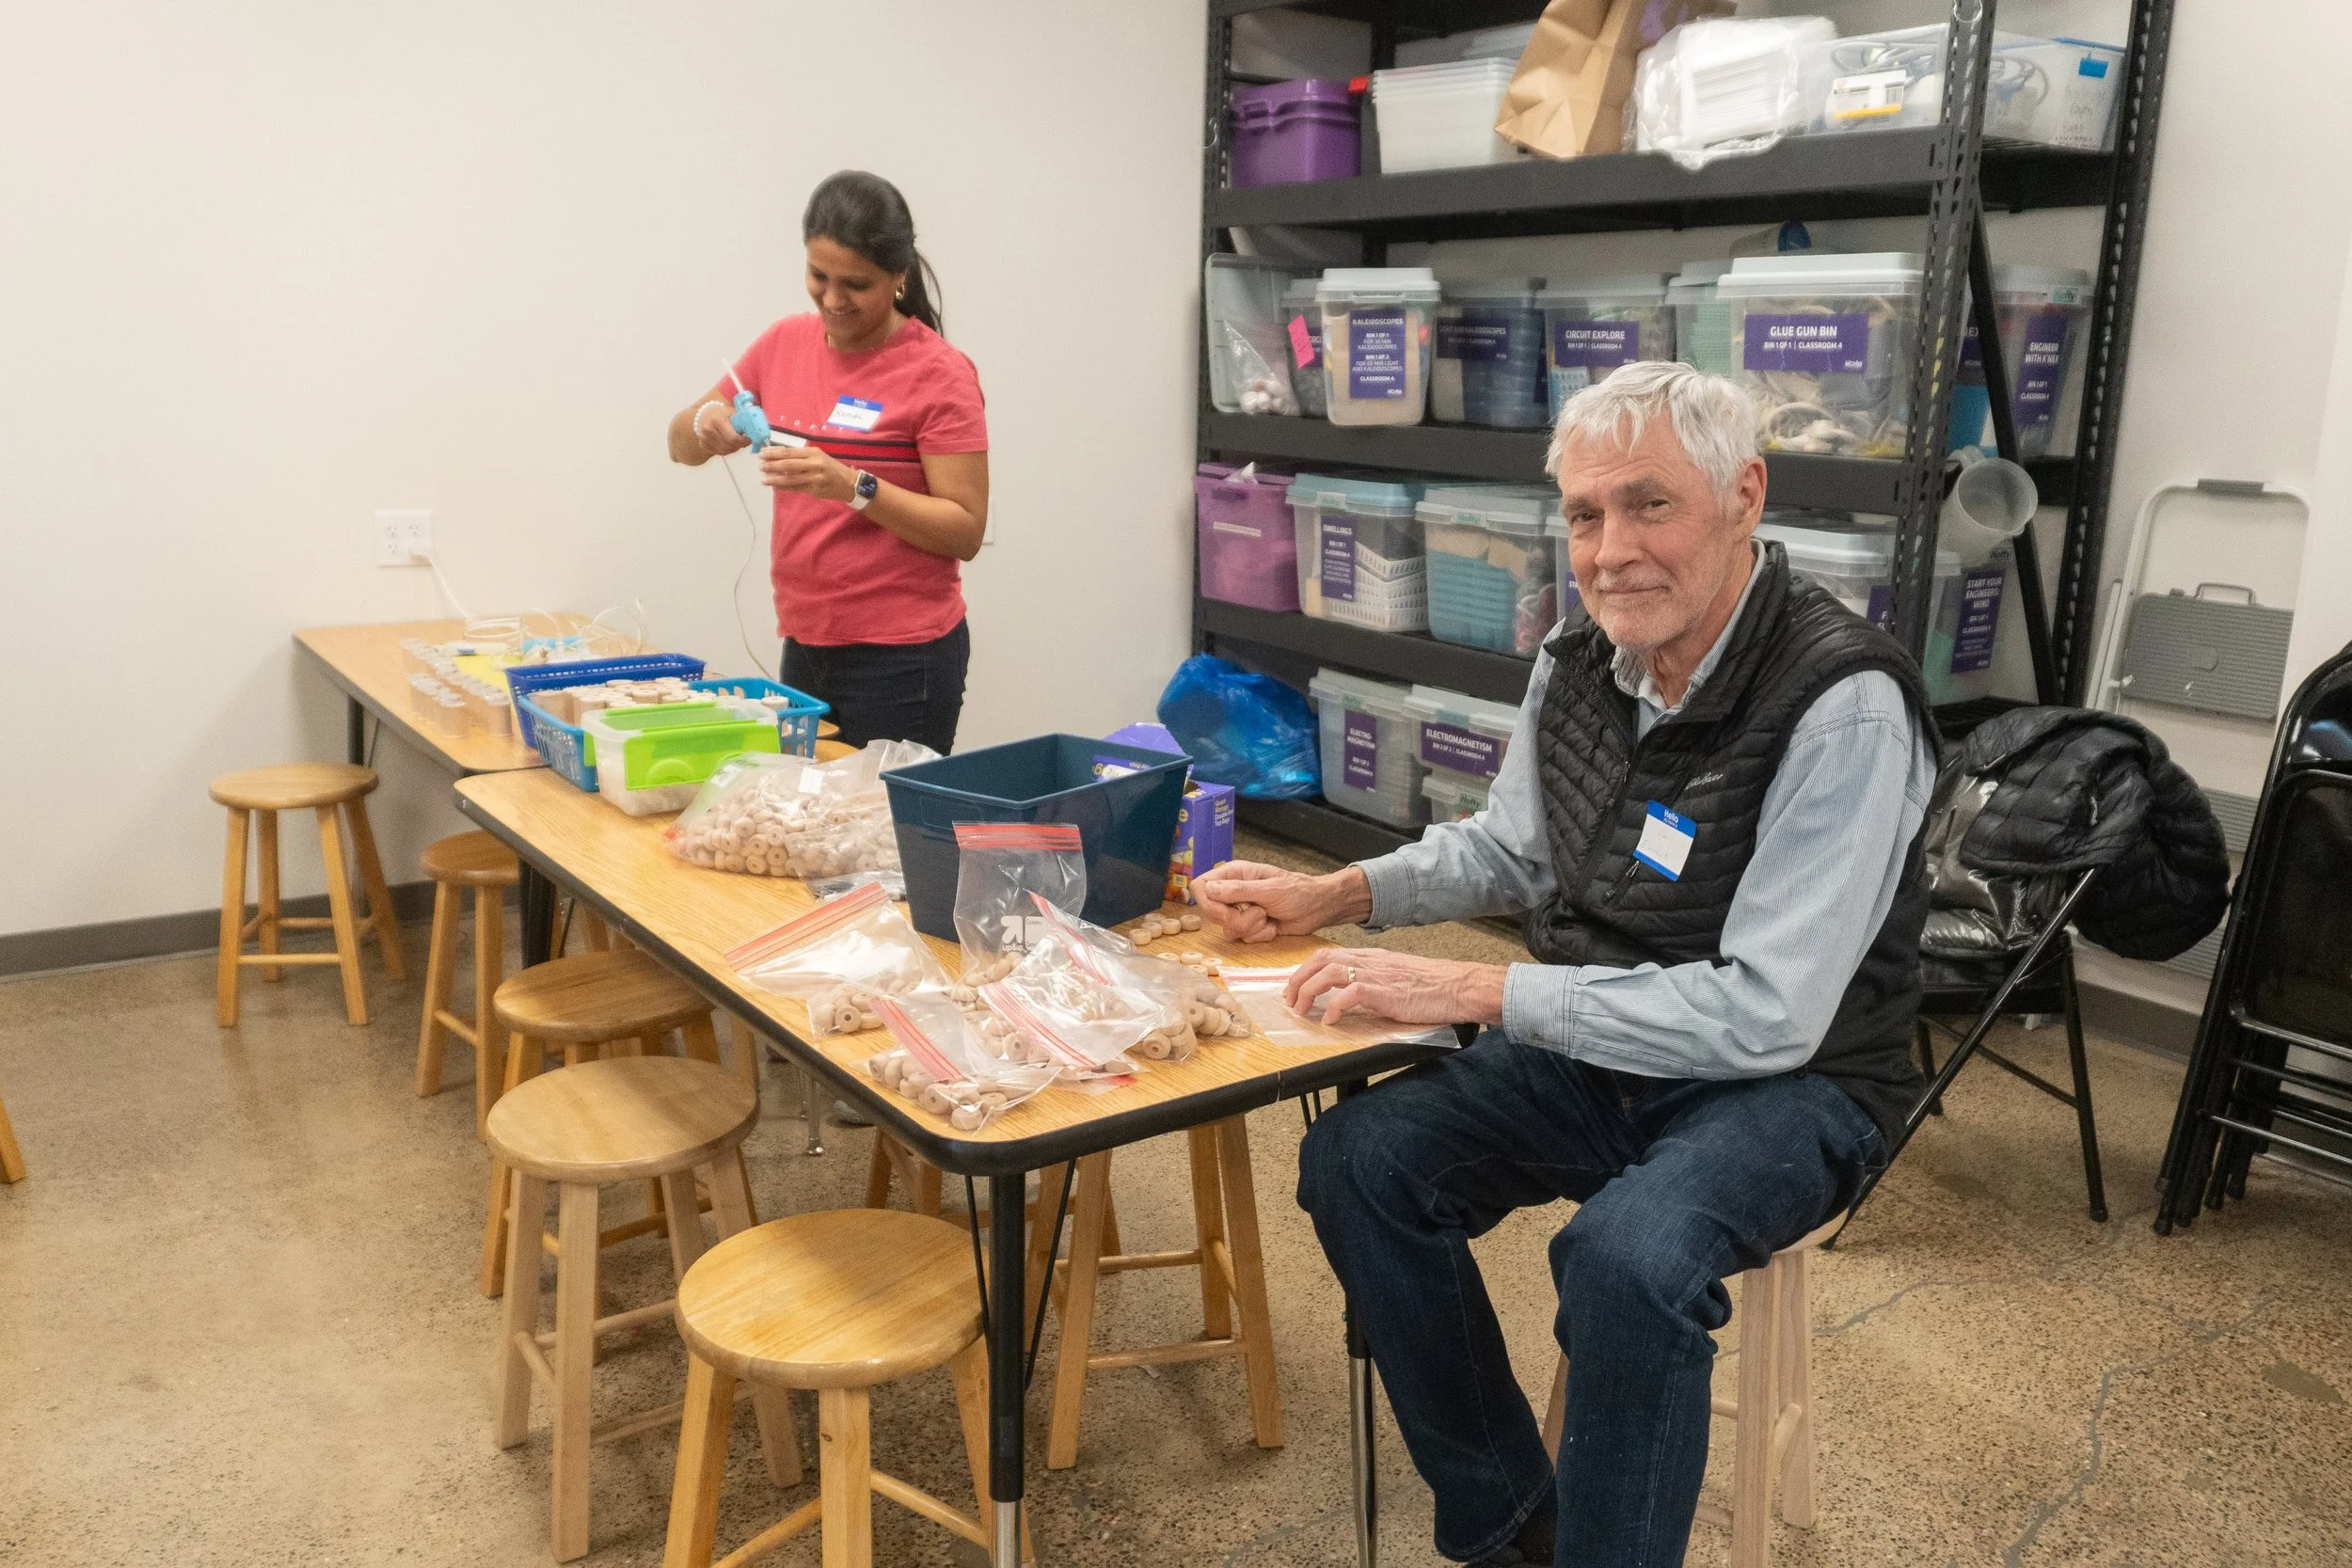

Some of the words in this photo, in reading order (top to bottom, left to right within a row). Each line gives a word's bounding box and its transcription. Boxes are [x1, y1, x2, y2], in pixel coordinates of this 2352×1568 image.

[1565, 330, 1591, 339] CIRCUIT
[1592, 330, 1626, 340] EXPLORE
[1770, 325, 1794, 337] GLUE
[1796, 325, 1818, 337] GUN
[1820, 325, 1837, 337] BIN
[1763, 341, 1775, 350] BIN
[1798, 341, 1836, 350] CLASSROOM
[2030, 342, 2058, 352] ENGINEER
[2025, 354, 2042, 364] WITH
[1323, 524, 1352, 535] DWELLINGS
[1967, 578, 1986, 589] START
[1987, 577, 2003, 586] YOUR
[1973, 599, 1991, 610] WIND
[1426, 729, 1493, 752] ELECTROMAGNETISM
[1455, 748, 1482, 760] CLASSROOM
[1215, 798, 1227, 807] Quart
[1664, 809, 1679, 823] Hello
